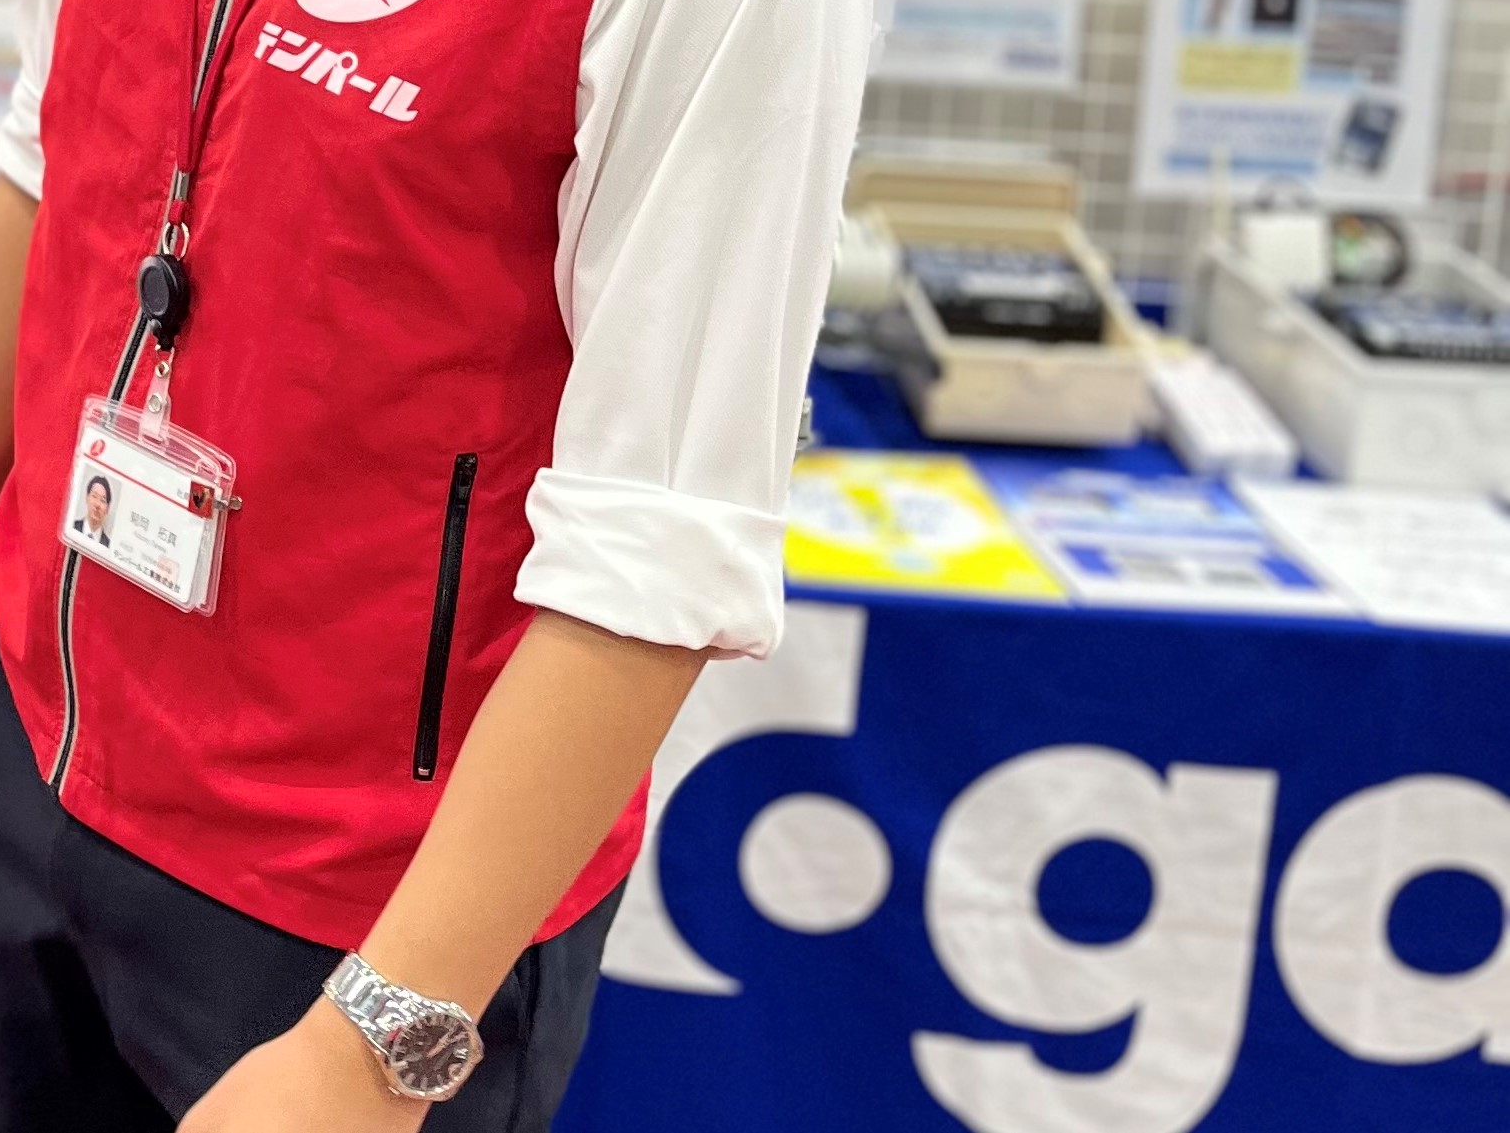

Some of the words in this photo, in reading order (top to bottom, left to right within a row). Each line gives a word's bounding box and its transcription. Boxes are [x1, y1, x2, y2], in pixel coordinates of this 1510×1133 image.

[253, 20, 422, 122] テンパール
